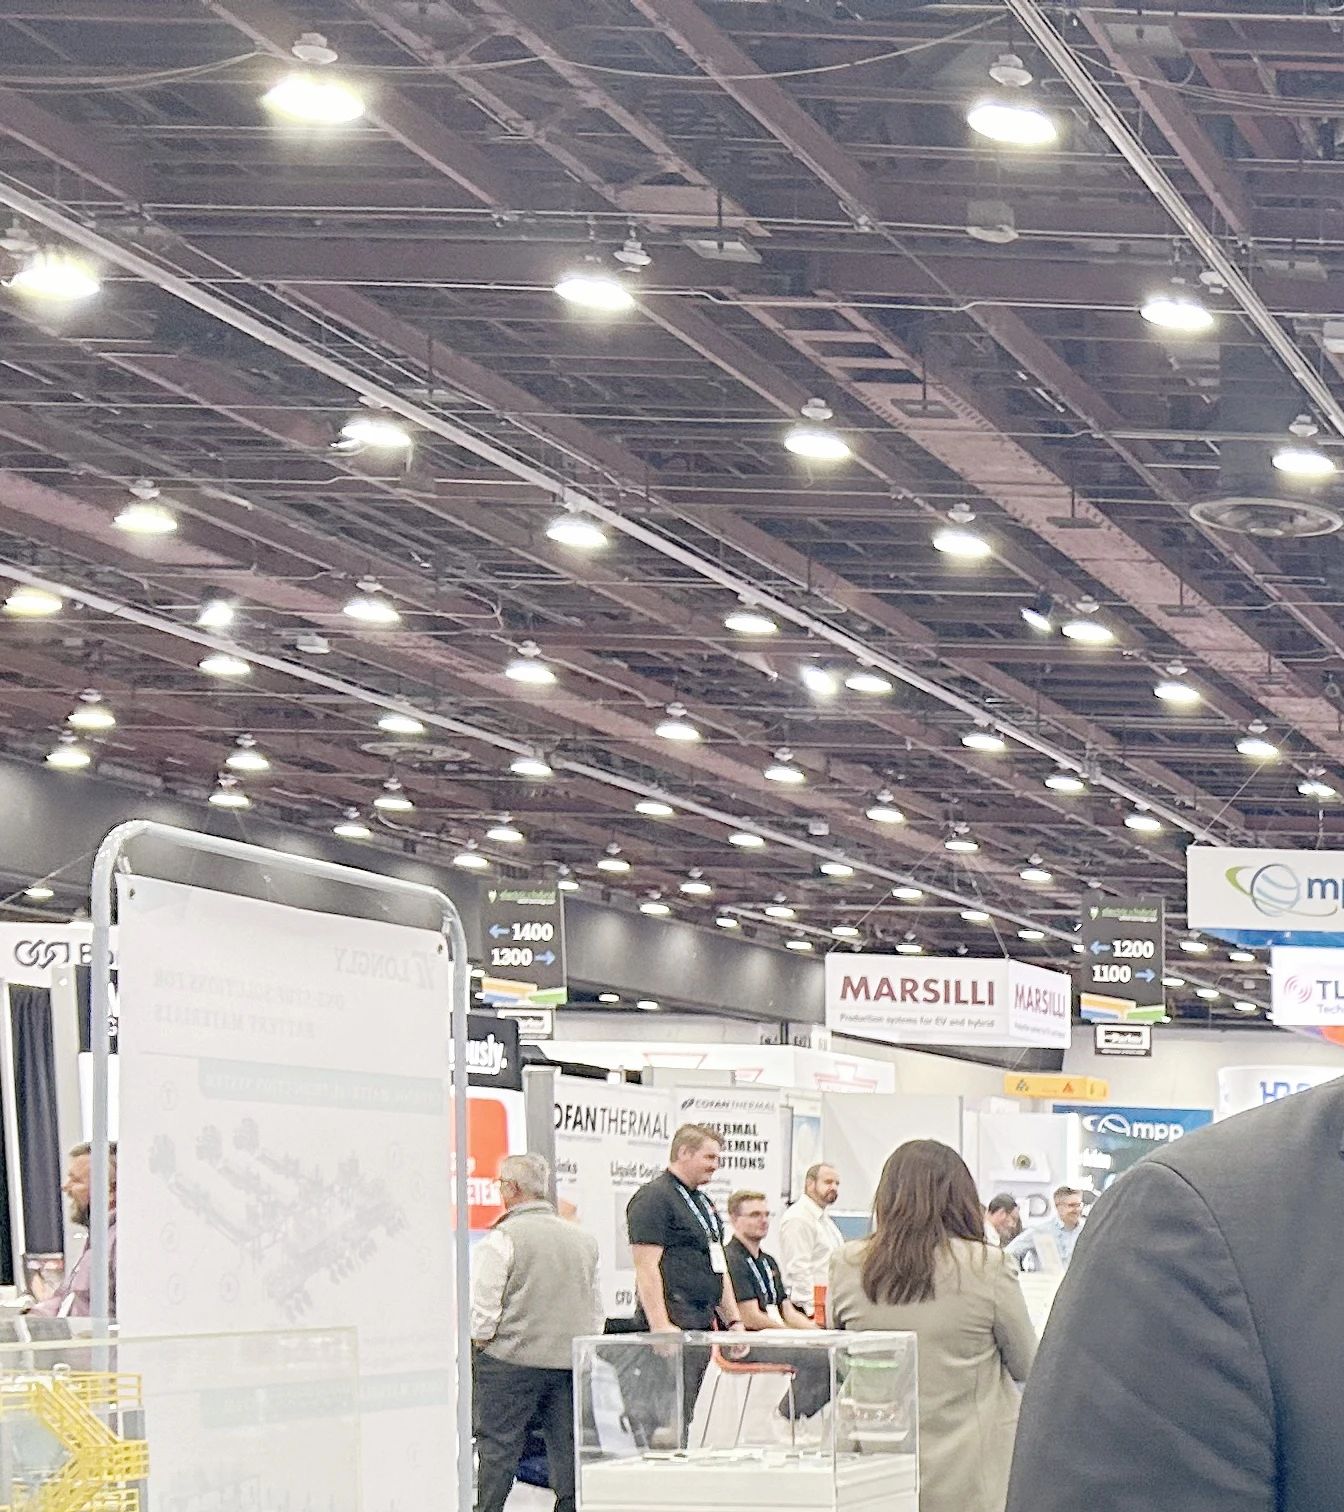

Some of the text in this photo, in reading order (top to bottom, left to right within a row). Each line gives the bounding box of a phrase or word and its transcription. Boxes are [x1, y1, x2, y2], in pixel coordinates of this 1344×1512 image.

[511, 922, 554, 942] 1400
[1112, 939, 1155, 959] 1200
[1092, 964, 1132, 984] 1100
[839, 975, 996, 1007] MARSILLI
[1014, 983, 1066, 1020] MARSILLI
[920, 1015, 933, 1026] for
[1132, 1120, 1185, 1143] mpp
